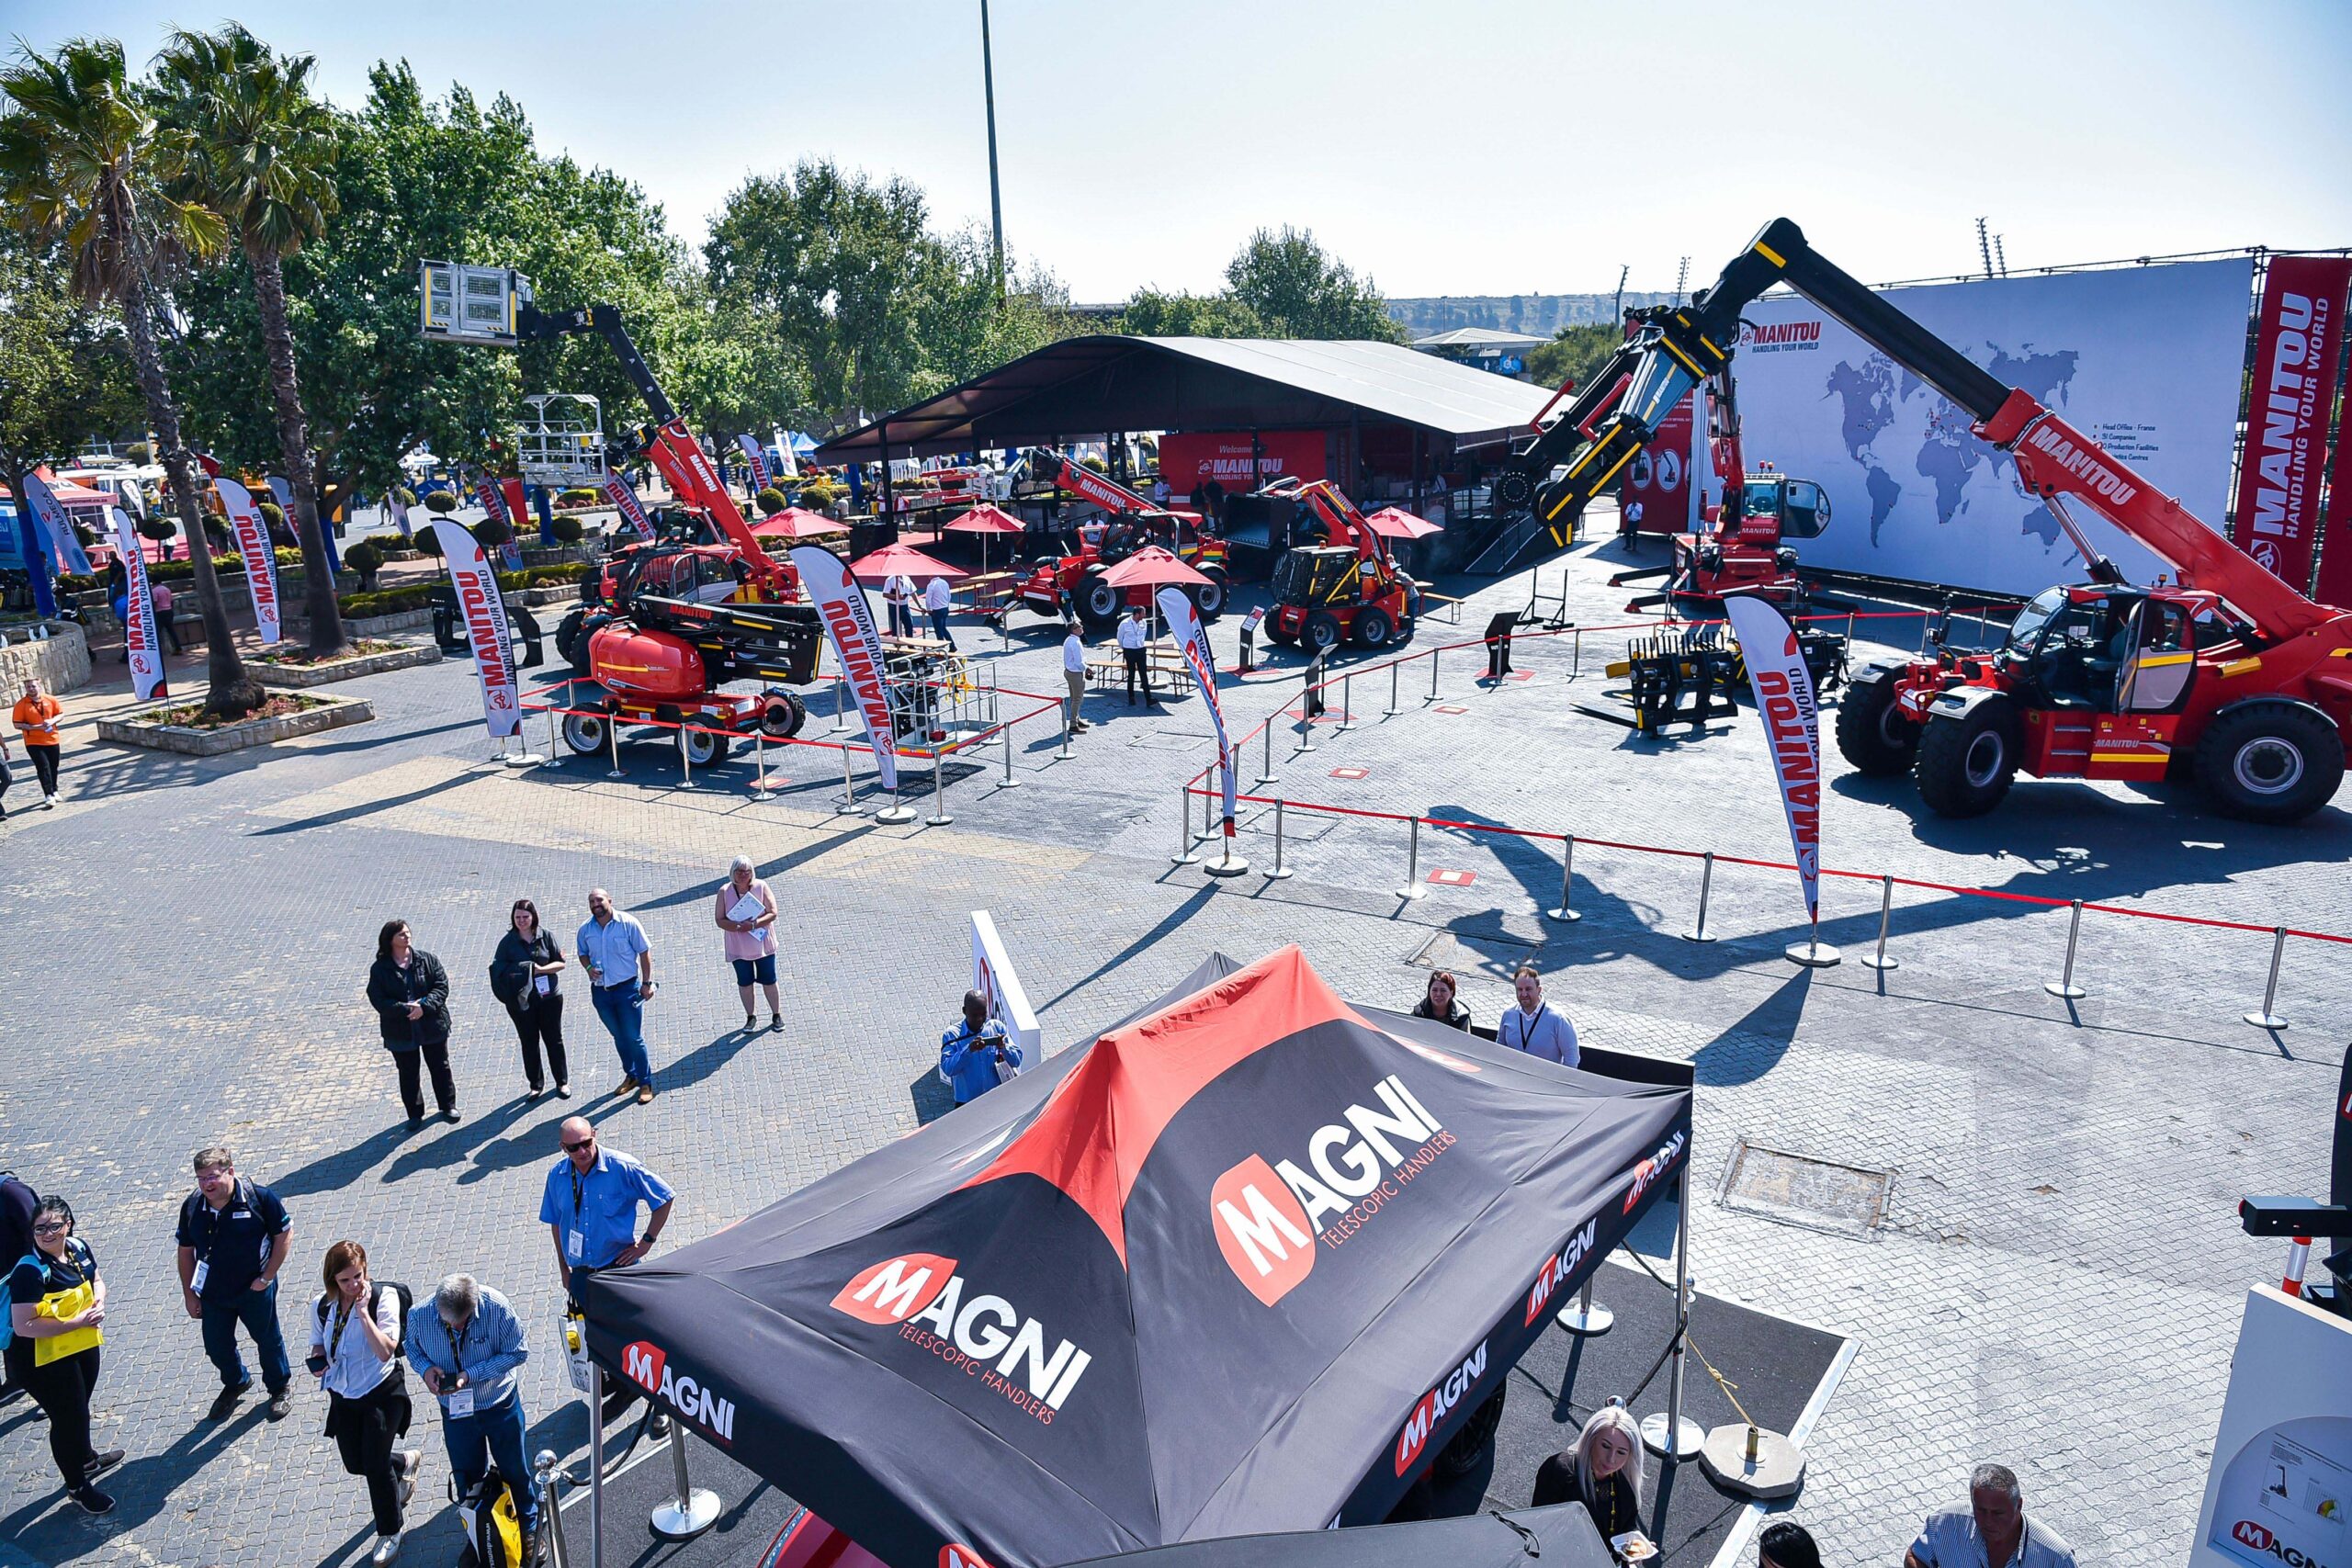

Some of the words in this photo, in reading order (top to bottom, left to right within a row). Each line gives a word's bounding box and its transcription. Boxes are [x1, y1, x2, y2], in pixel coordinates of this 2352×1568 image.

[1752, 344, 1781, 354] HANDLING
[1782, 343, 1797, 352] YOUR
[1798, 342, 1819, 350] WORLD
[1754, 321, 1821, 344] MANITOU
[2109, 434, 2136, 442] Companies
[2254, 292, 2313, 536] MANITOU
[2286, 436, 2309, 539] HANDLING
[2299, 374, 2317, 431] YOUR
[2308, 297, 2329, 373] WORLD
[689, 454, 718, 492] MANITOU
[1219, 446, 1252, 454] Welcome
[2029, 424, 2137, 505] MANITOU
[42, 491, 70, 536] RULMECA
[606, 482, 650, 536] MANITOU
[1080, 479, 1127, 508] MANITOU
[1328, 486, 1354, 513] MANITOU
[252, 513, 268, 540] WORLD
[233, 515, 275, 604] MANITOU
[259, 541, 274, 562] YOUR
[128, 549, 145, 651] MANITOU
[139, 579, 150, 603] YOUR
[479, 570, 496, 605] WORLD
[669, 604, 712, 620] MANITOU
[141, 602, 157, 651] HANDLING
[456, 571, 507, 687] MANITOU
[491, 608, 503, 633] YOUR
[848, 595, 870, 631] WORLD
[499, 636, 515, 685] HANDLING
[821, 600, 891, 728] MANITOU
[865, 634, 882, 668] YOUR
[1788, 668, 1816, 722] WORLD
[1756, 670, 1820, 843] MANITOU
[2095, 739, 2140, 748] MANITOU
[1216, 1074, 1443, 1277] MAGNI
[1320, 1180, 1398, 1249] TELESCOPIC
[1393, 1130, 1457, 1186] HANDLERS
[1531, 1217, 1597, 1315] MAGNI
[853, 1259, 1092, 1411] MAGNI
[628, 1345, 735, 1440] MAGNI
[898, 1323, 982, 1376] TELESCOPIC
[981, 1369, 1056, 1425] HANDLERS
[1401, 1338, 1488, 1461] MAGNI
